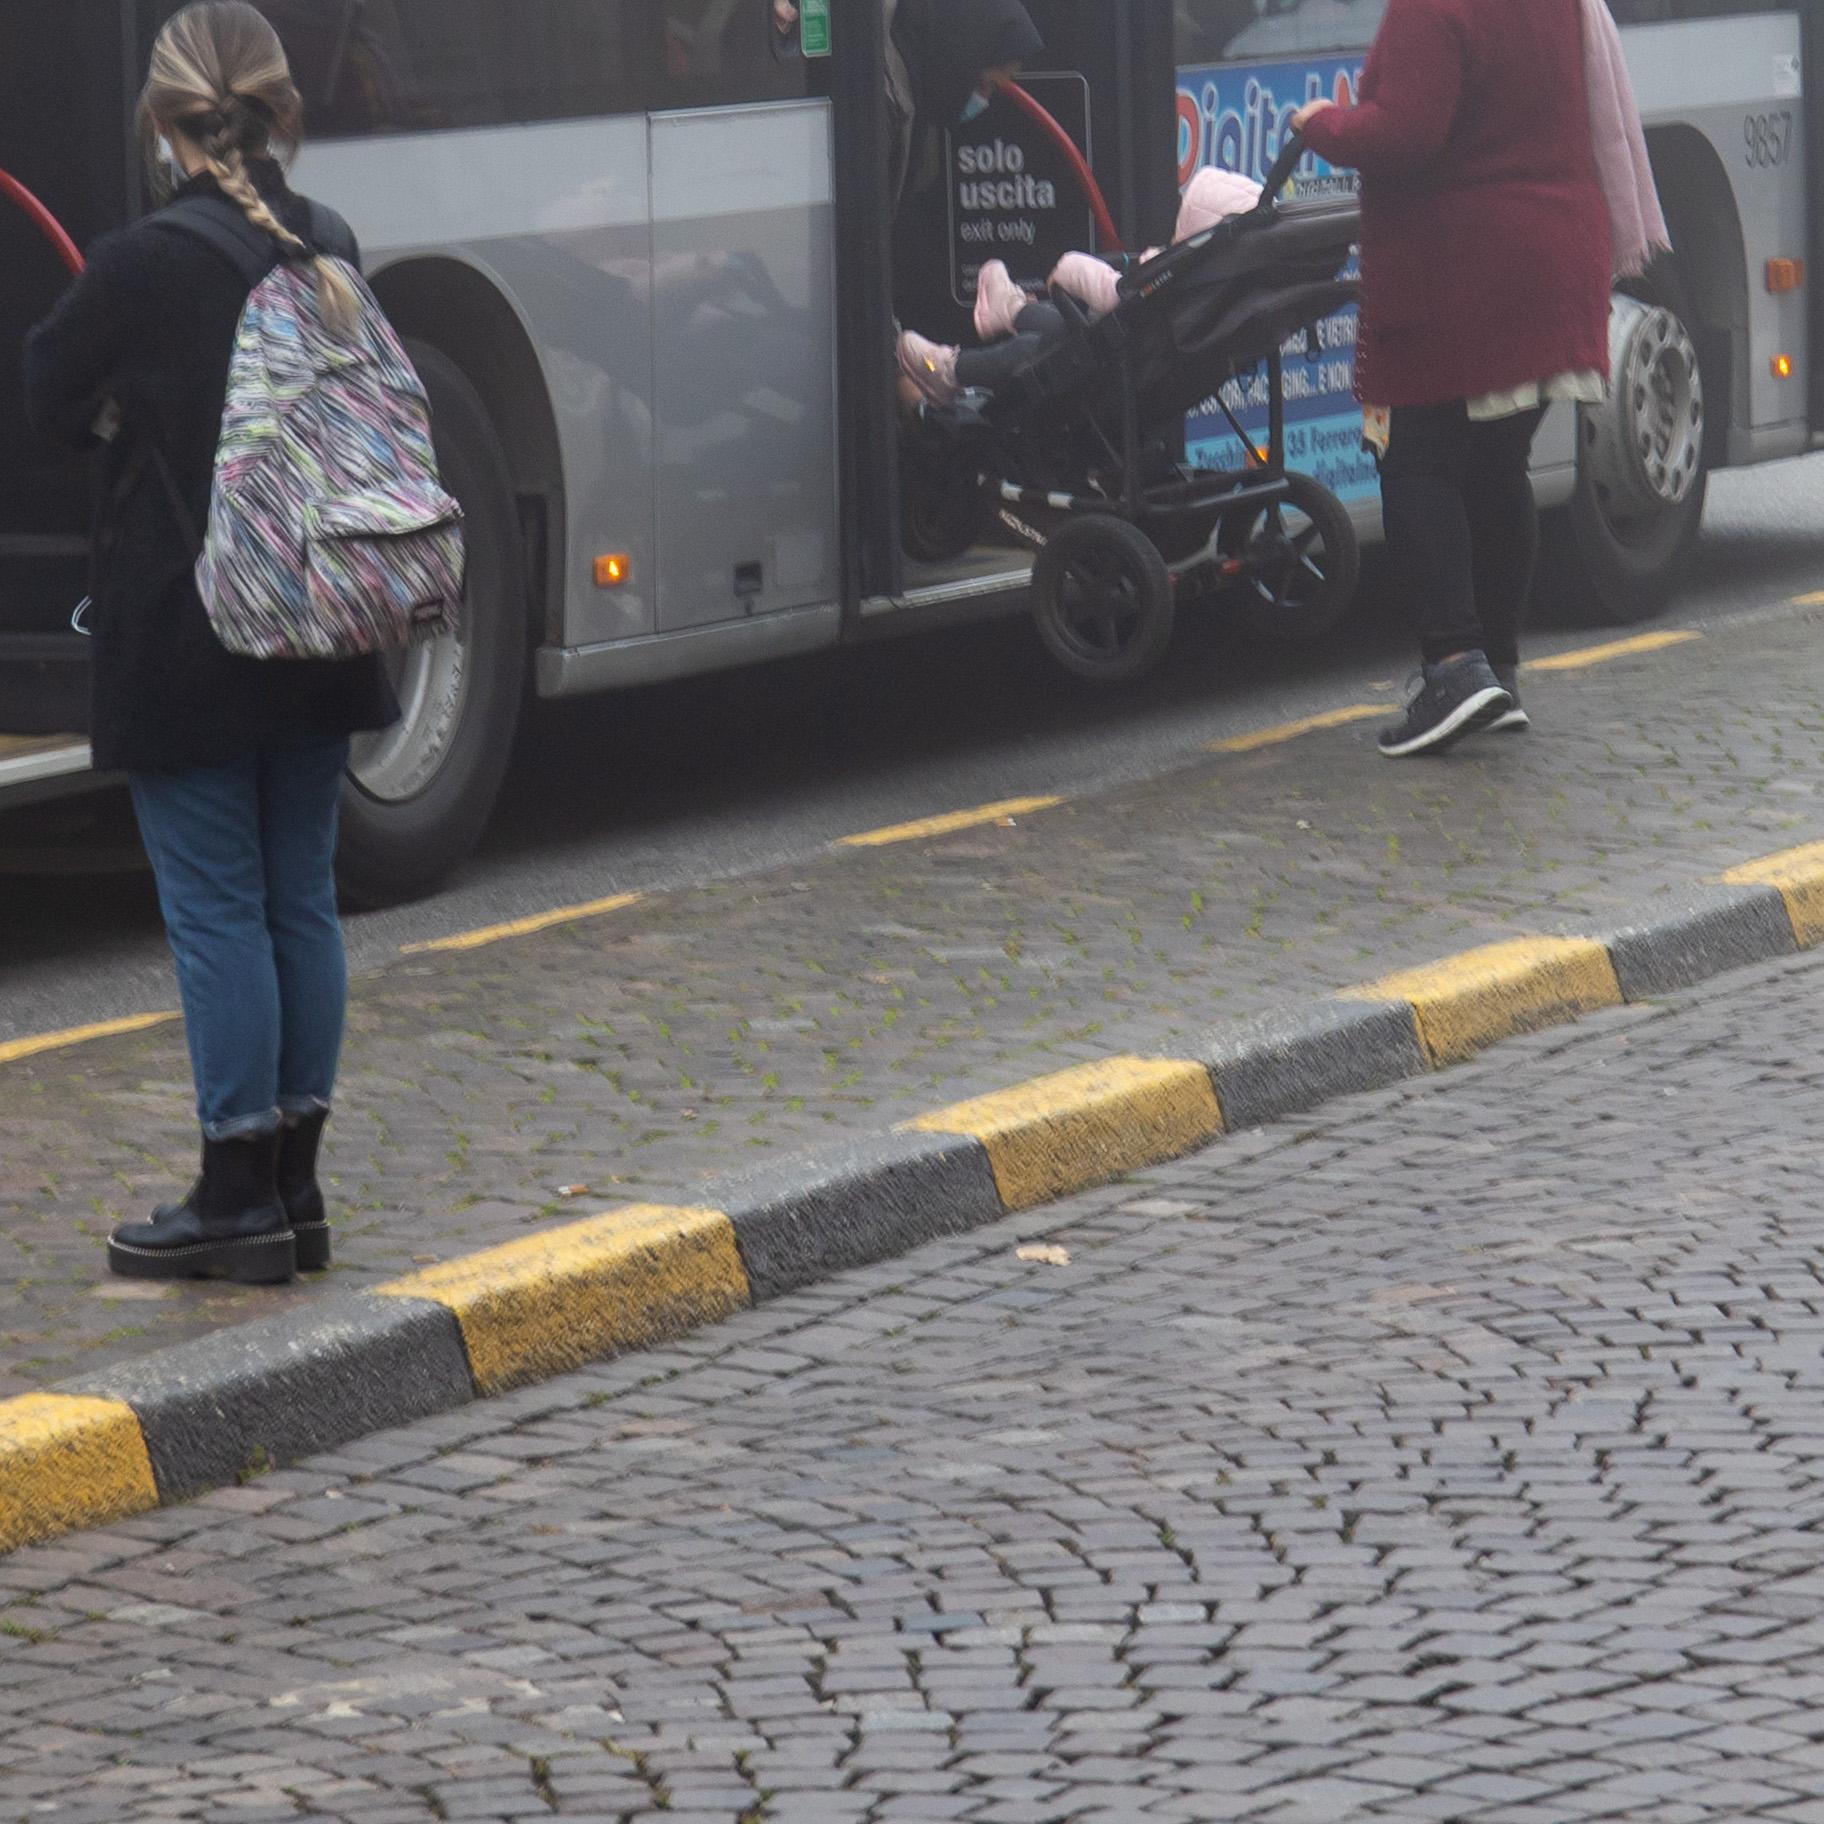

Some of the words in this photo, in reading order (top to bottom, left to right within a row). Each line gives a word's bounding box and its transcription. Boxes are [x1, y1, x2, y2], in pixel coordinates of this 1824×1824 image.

[957, 137, 1025, 174] solo
[1743, 111, 1792, 169] 9857
[959, 173, 1057, 211] uscita
[960, 217, 995, 242] exit
[997, 217, 1037, 246] only
